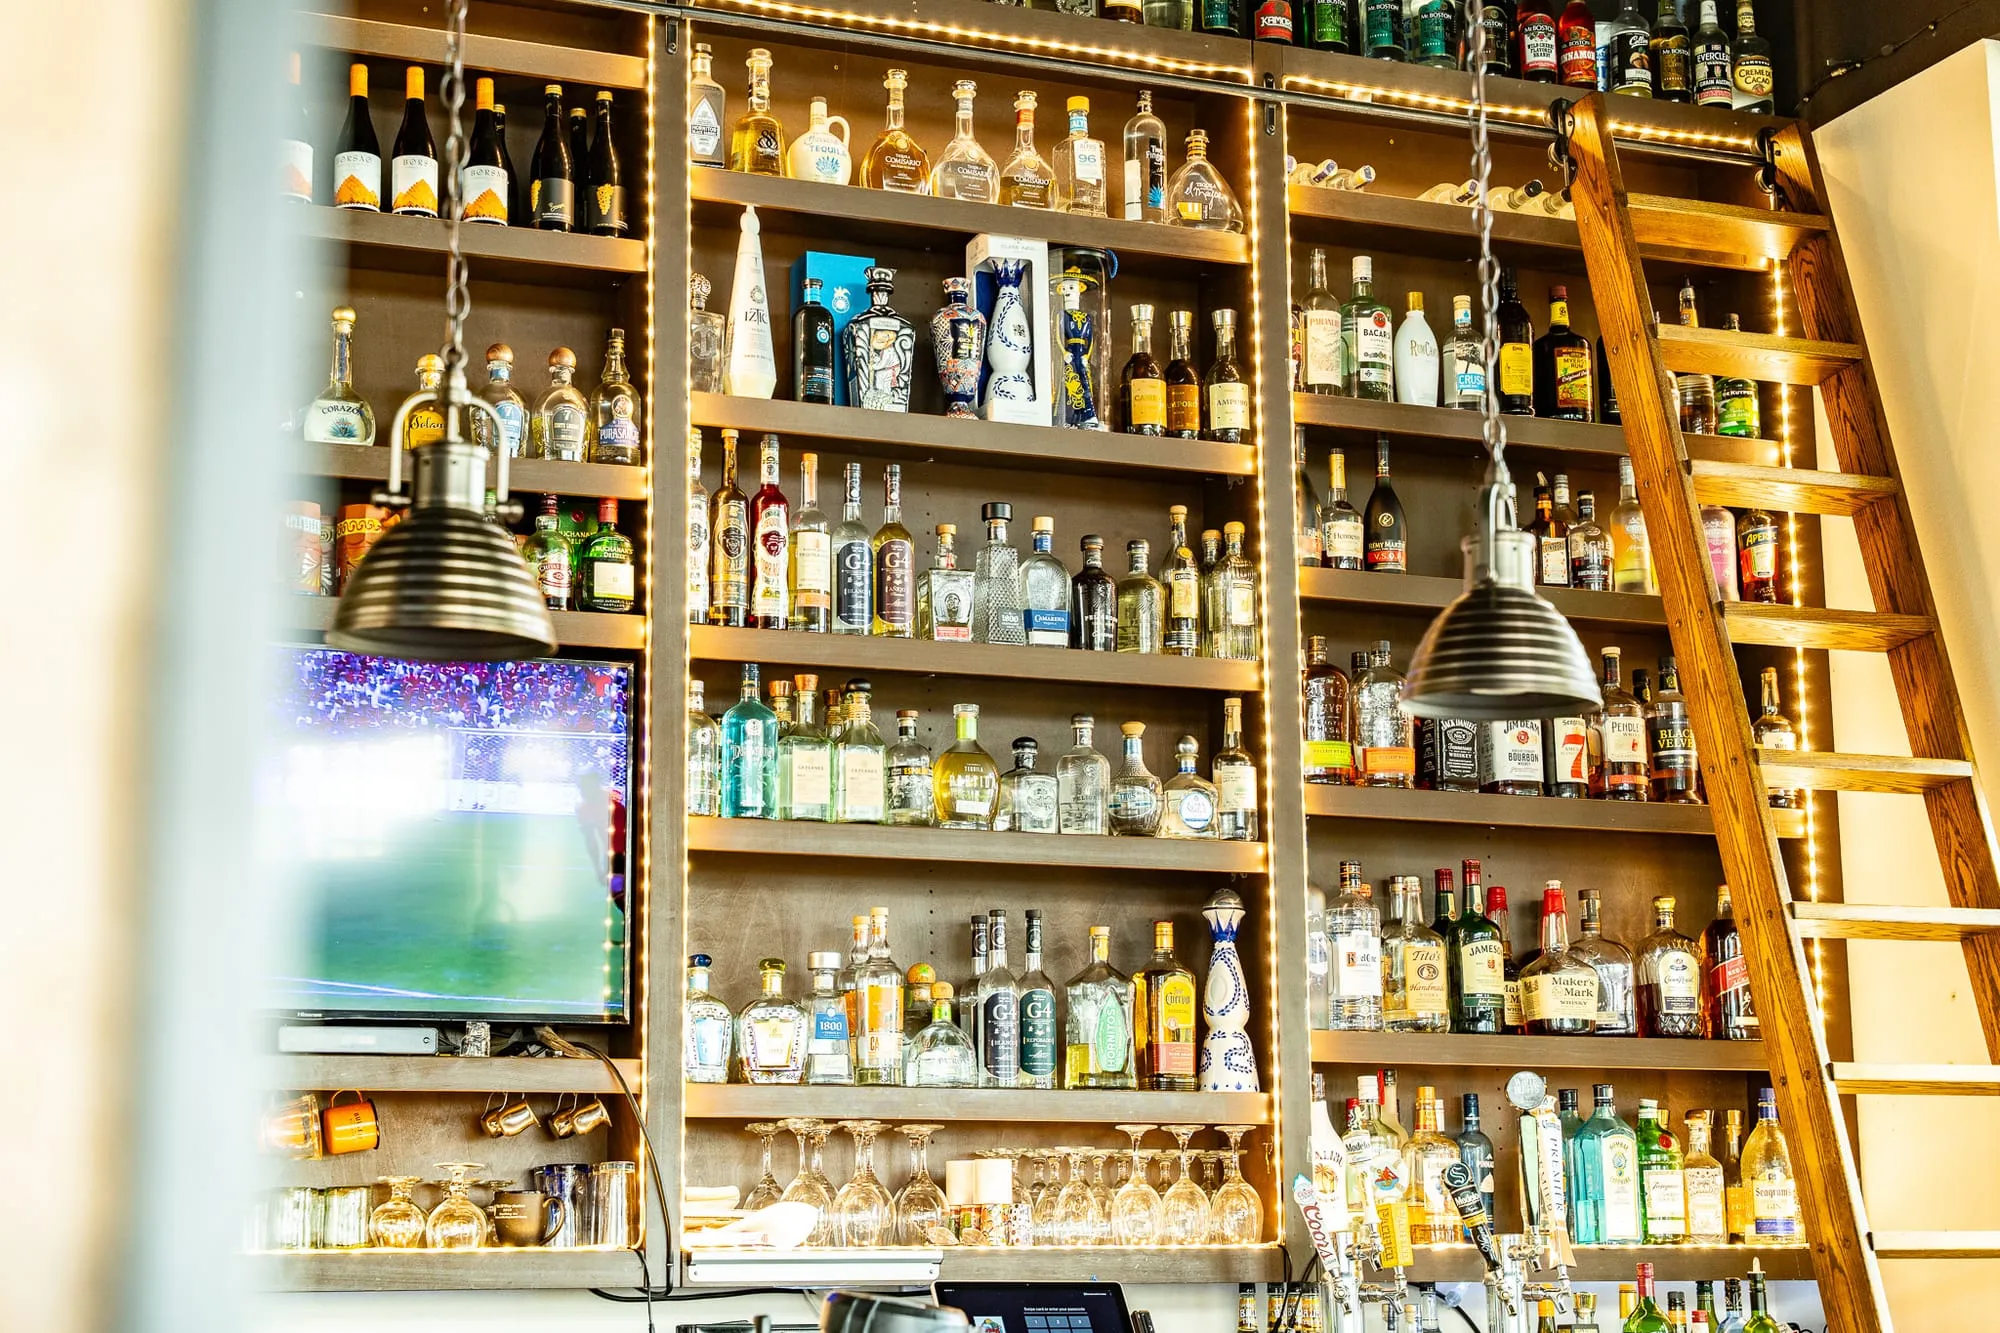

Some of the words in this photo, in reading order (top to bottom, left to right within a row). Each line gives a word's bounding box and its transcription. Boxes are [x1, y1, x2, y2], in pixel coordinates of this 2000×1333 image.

[1378, 3, 1399, 11] BOSTON
[1431, 12, 1452, 20] BOSTON
[1078, 154, 1098, 164] 96
[1658, 738, 1694, 749] VELVE
[1508, 752, 1539, 763] BOURBON
[1562, 733, 1586, 779] 7
[1412, 950, 1441, 961] Tito's
[1551, 976, 1595, 987] Maker's
[1563, 988, 1594, 998] Mark
[1026, 1002, 1052, 1019] G4
[820, 1021, 843, 1031] 1800
[1107, 1007, 1117, 1069] HORNITOS
[1303, 1203, 1334, 1261] Coors
